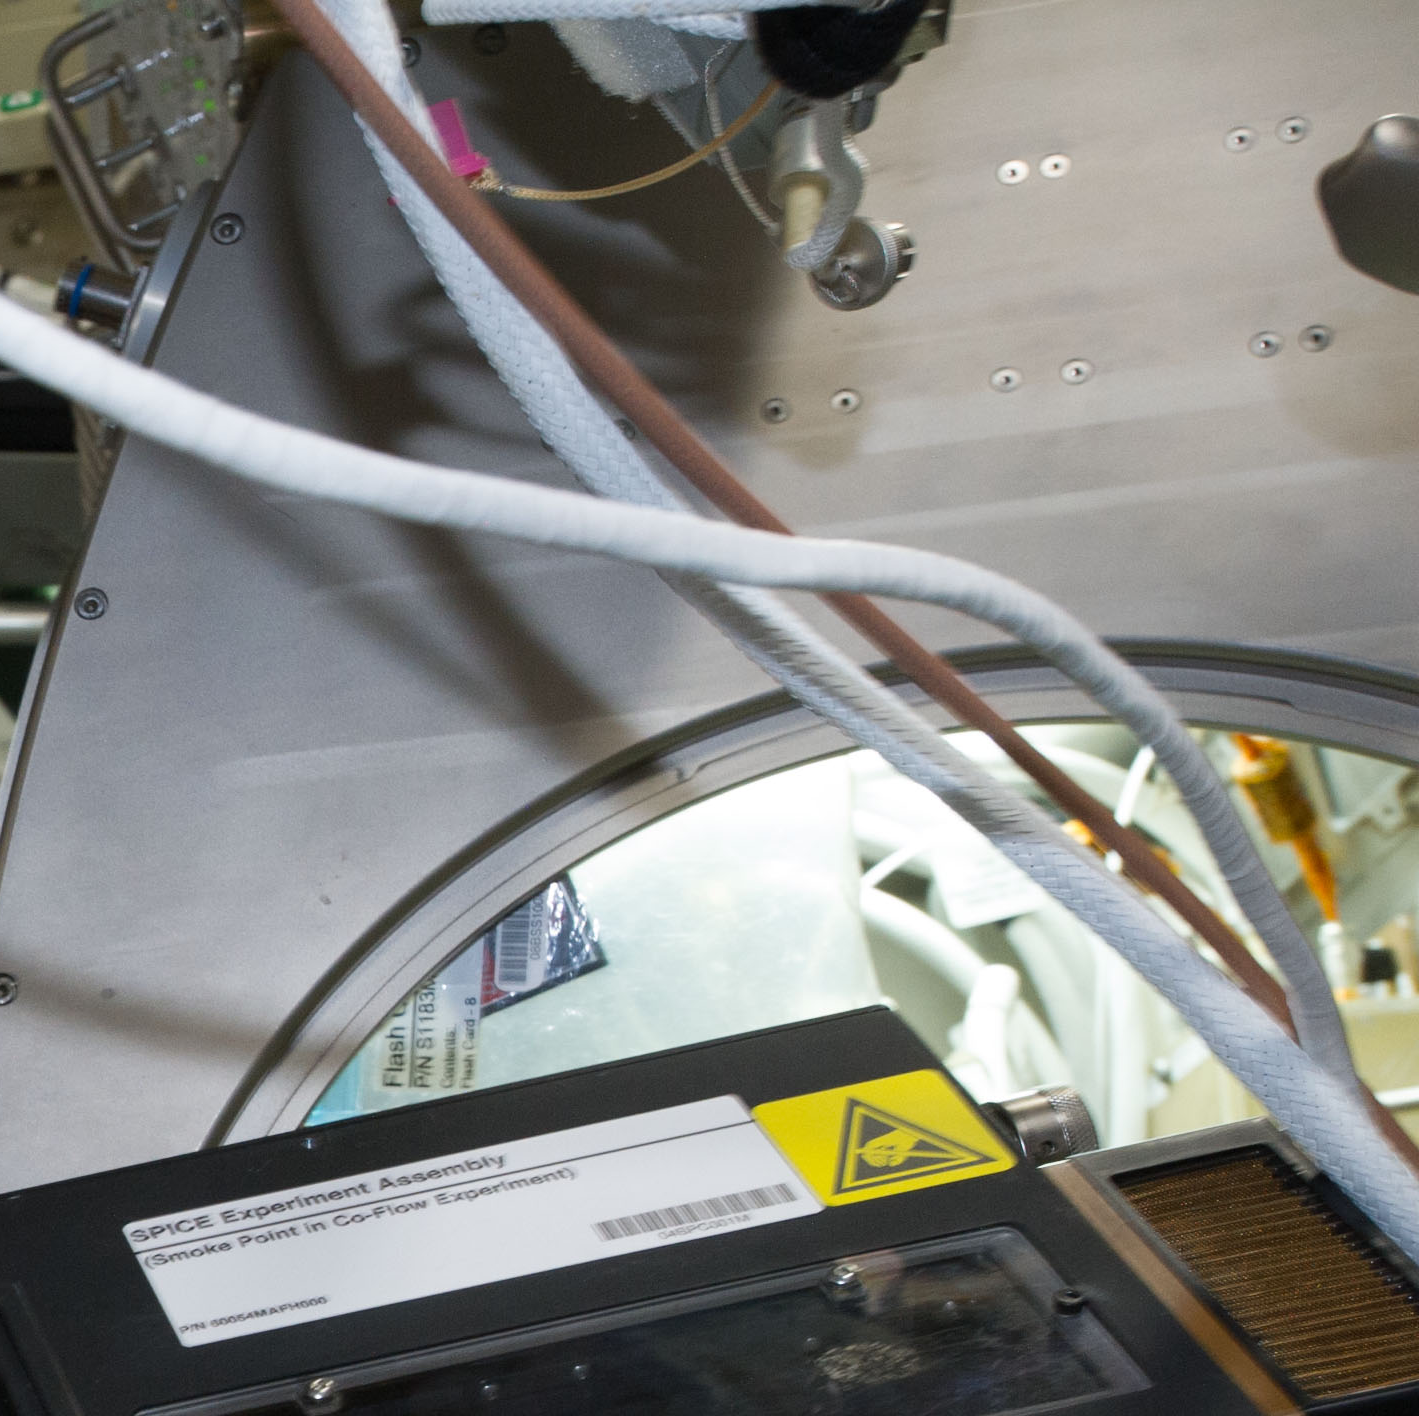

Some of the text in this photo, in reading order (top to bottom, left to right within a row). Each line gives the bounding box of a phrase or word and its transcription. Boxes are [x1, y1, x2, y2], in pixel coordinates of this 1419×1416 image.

[529, 896, 543, 960] 08BSS100
[465, 996, 476, 1006] 8
[462, 1019, 476, 1050] Card
[383, 1026, 406, 1087] Flash
[414, 1056, 435, 1088] P/N
[459, 1054, 476, 1089] Flash
[130, 1153, 507, 1244] SPICE Experiment Assembly
[144, 1166, 578, 1270] (Smoke Point in Co-Flow Experiment)
[179, 1321, 206, 1335] P/N
